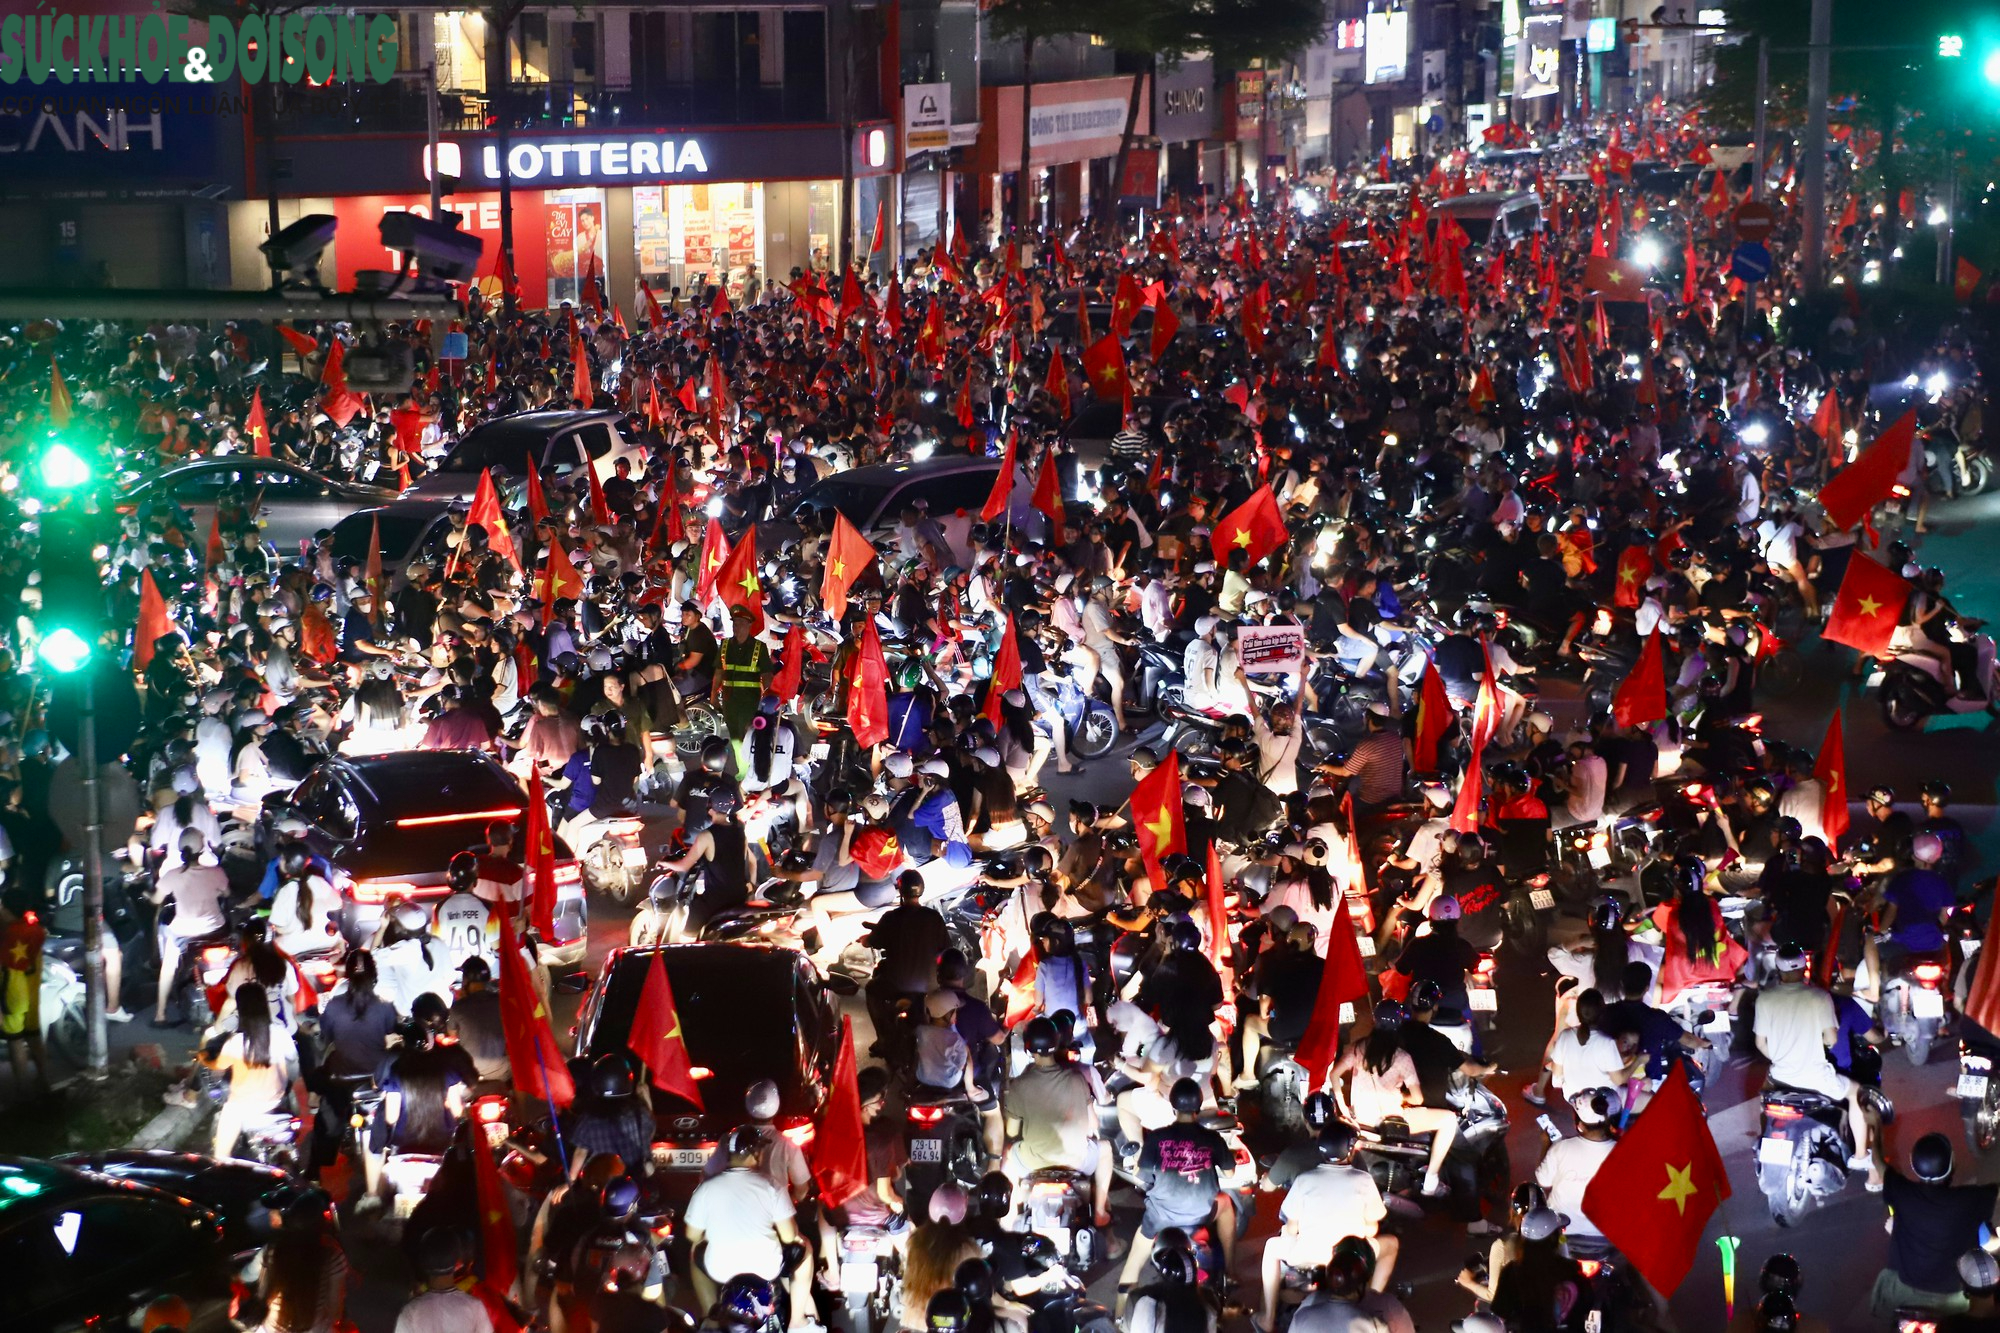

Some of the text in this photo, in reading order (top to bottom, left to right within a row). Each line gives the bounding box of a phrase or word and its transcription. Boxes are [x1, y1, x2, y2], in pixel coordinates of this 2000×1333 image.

[1166, 86, 1206, 116] SHINKO
[1071, 108, 1122, 131] BARBERSHOP
[483, 140, 708, 179] LOTTERIA
[59, 220, 77, 238] 15
[462, 910, 479, 919] PEPE
[448, 924, 482, 956] 49
[915, 1140, 937, 1150] 29-L1
[912, 1151, 939, 1161] 584.94
